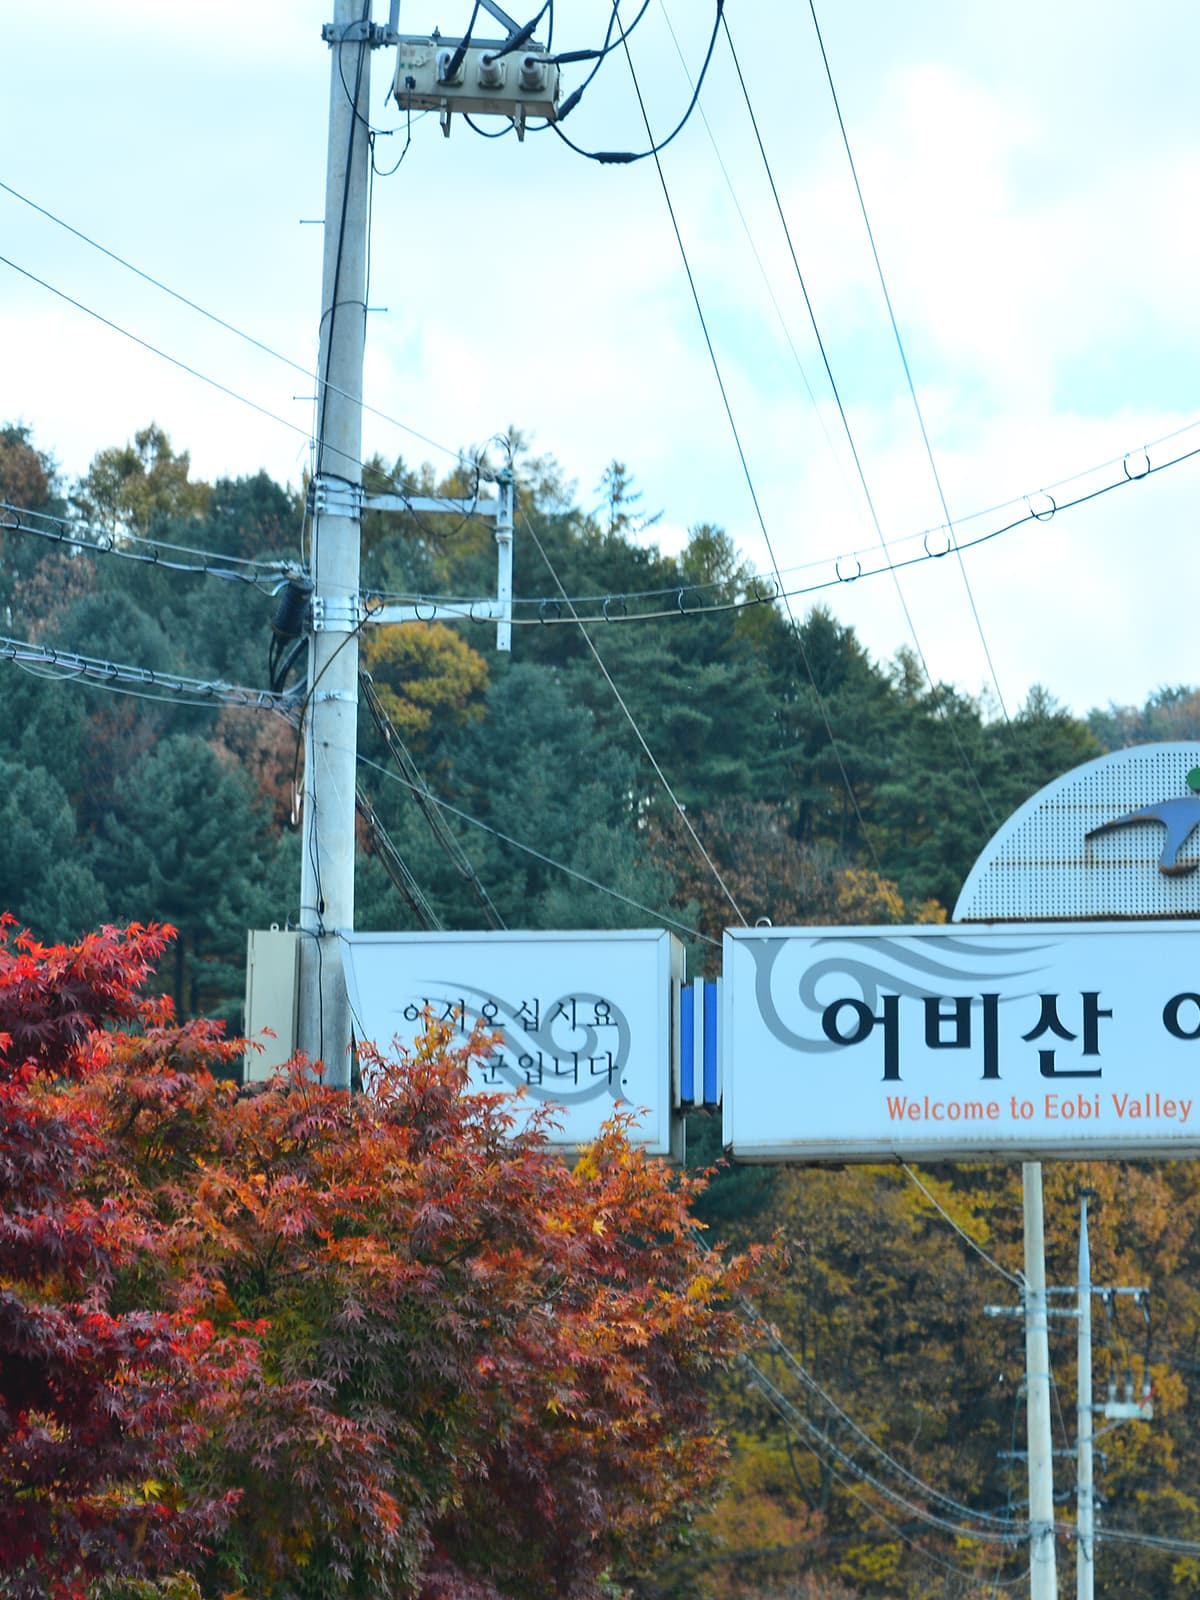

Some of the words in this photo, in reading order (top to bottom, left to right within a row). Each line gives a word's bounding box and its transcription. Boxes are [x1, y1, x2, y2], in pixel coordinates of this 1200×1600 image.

[822, 992, 1113, 1081] 어비산
[886, 1095, 1001, 1121] Welcome
[1010, 1097, 1035, 1121] to
[1044, 1093, 1101, 1120] Eobi
[1111, 1093, 1193, 1124] Valley
